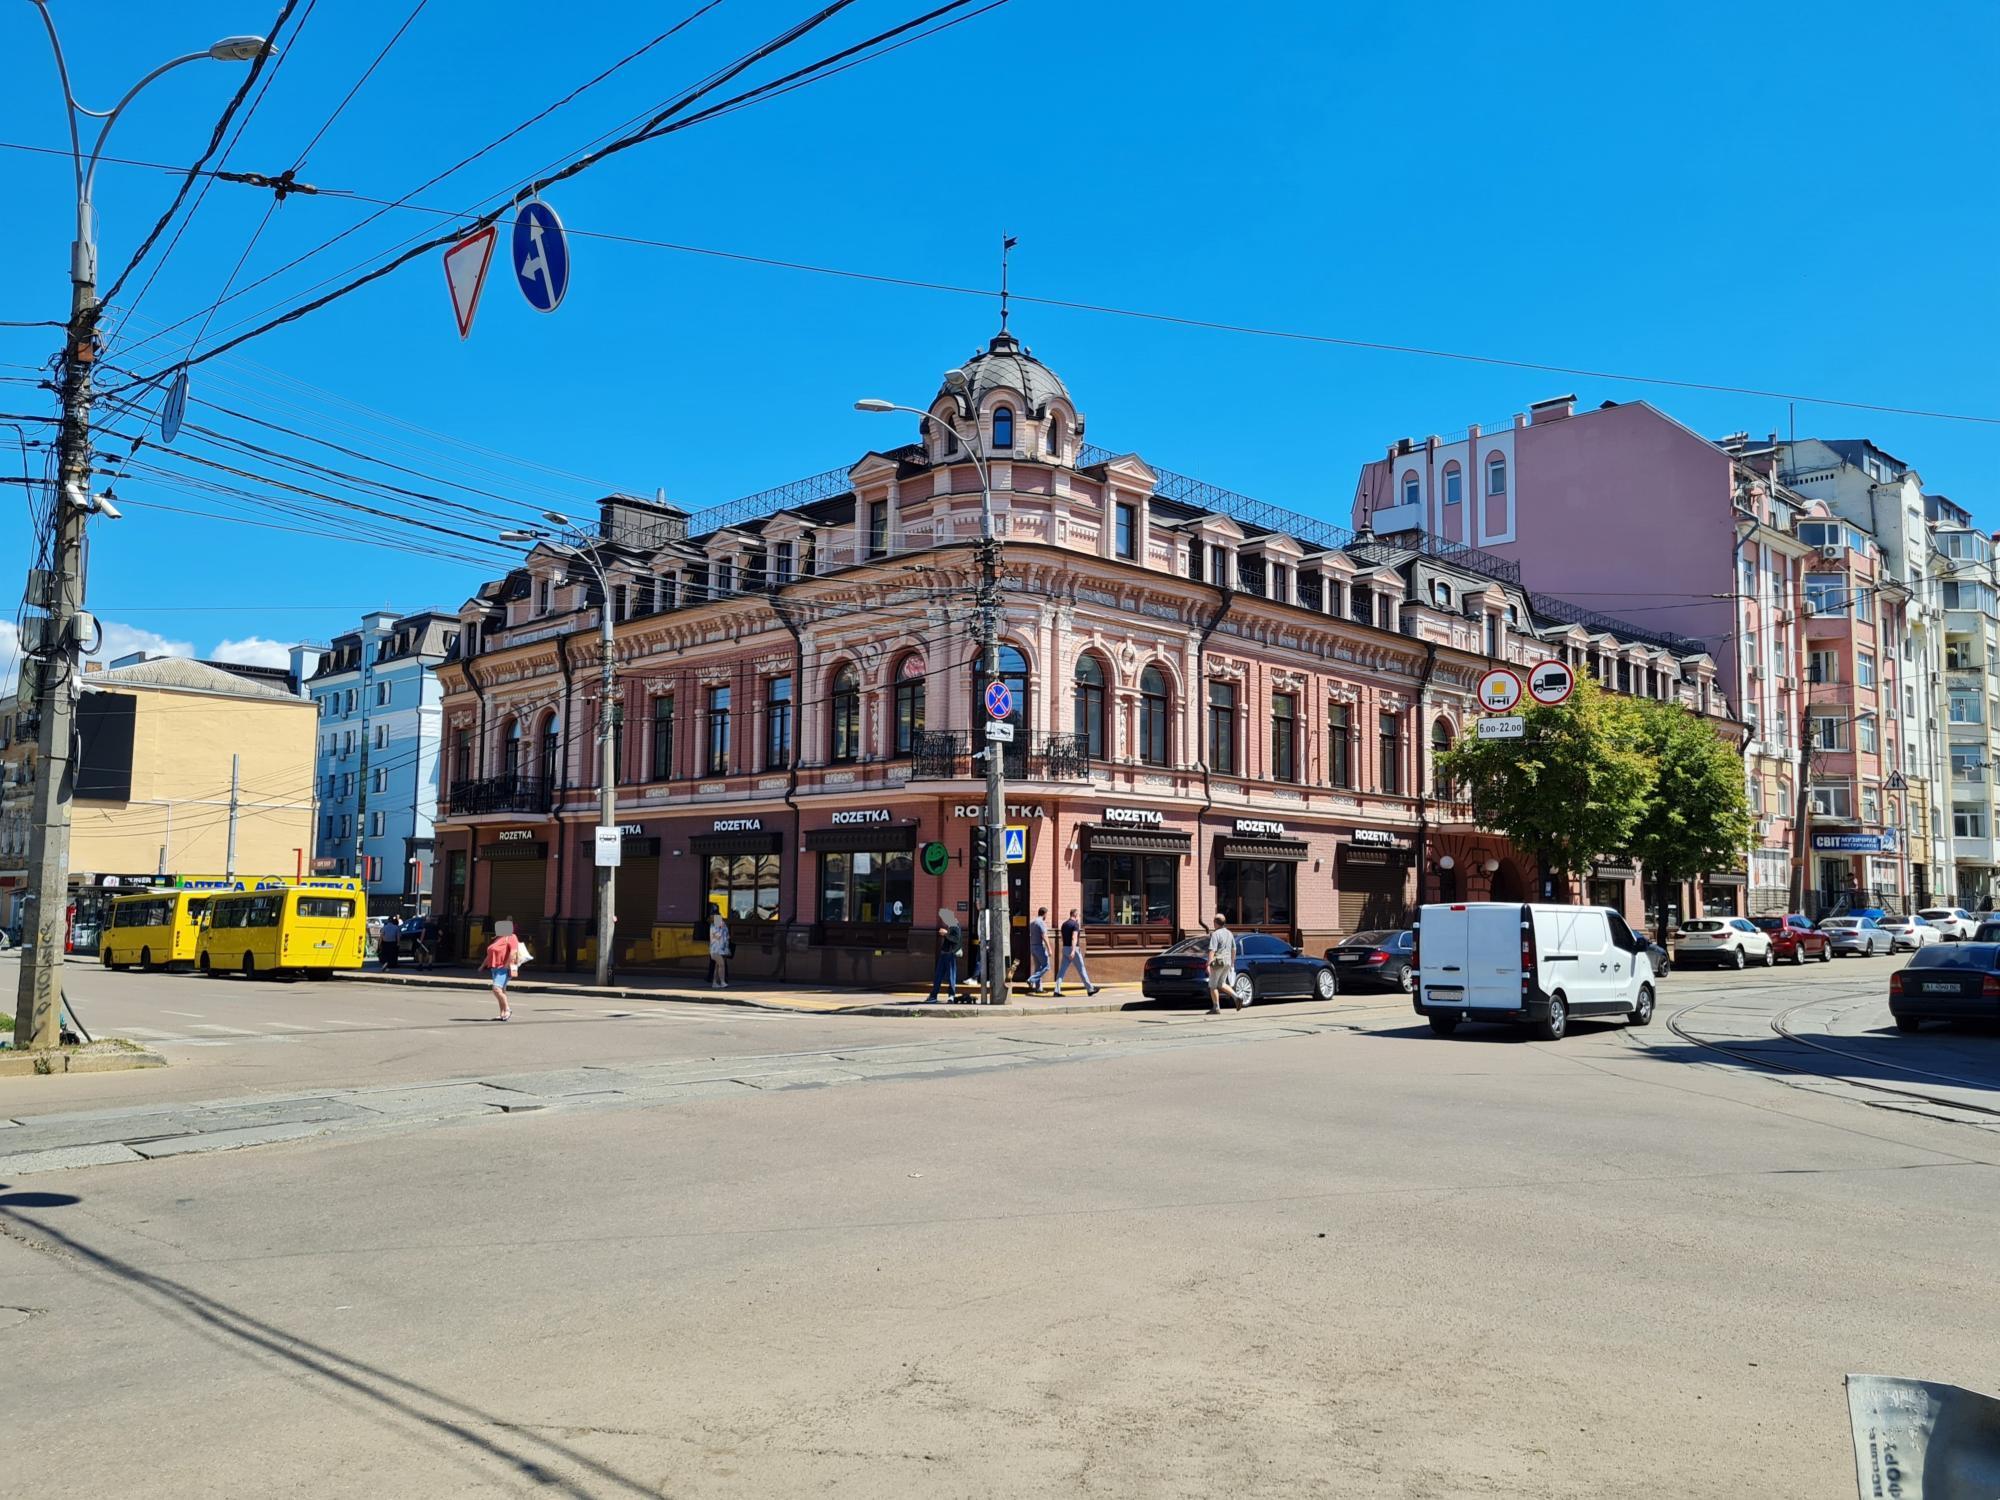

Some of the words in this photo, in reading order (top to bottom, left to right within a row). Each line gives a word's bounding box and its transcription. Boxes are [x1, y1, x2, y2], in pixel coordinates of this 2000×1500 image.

[1479, 722, 1522, 733] 6.00-22.00
[832, 810, 890, 824] ROZETKA
[954, 805, 1045, 818] ROTKA
[1105, 808, 1164, 823] ROZETKA
[620, 824, 642, 835] ETKA
[714, 819, 761, 831] ROZETKA
[1236, 820, 1285, 833] ROZETKA
[499, 830, 532, 840] ROZETKA
[1355, 829, 1395, 842] ROZETKA
[1816, 836, 1840, 847] СВІТ
